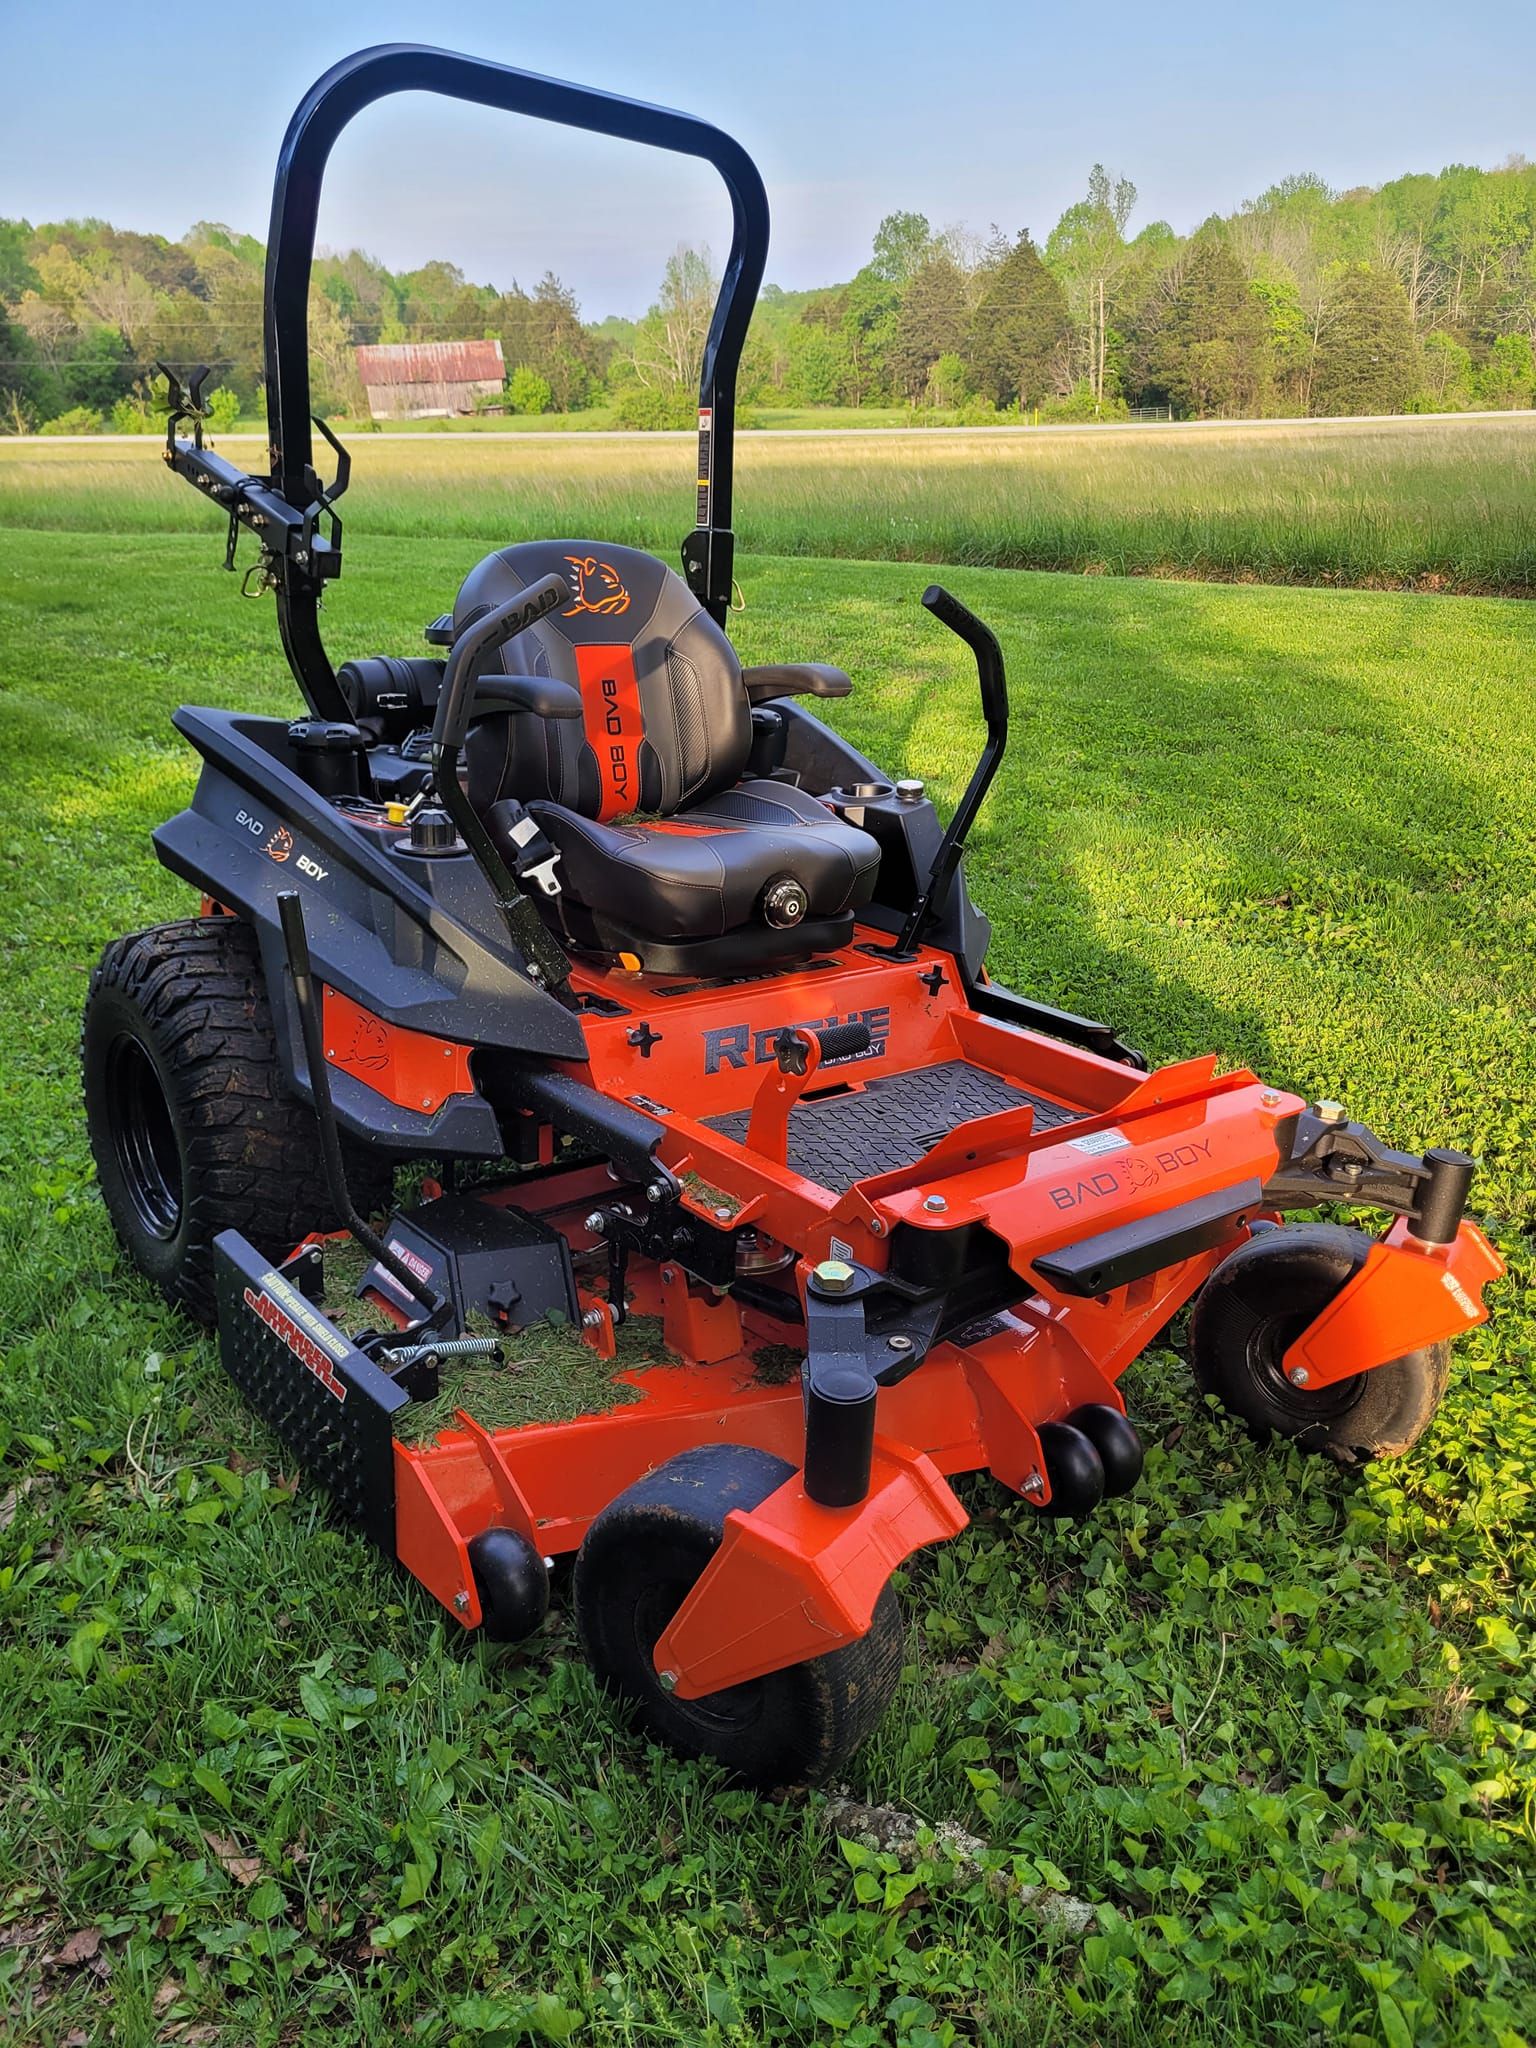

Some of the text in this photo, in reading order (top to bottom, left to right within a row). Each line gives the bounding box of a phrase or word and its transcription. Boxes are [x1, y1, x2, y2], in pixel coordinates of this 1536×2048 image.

[500, 587, 559, 633] BAD
[601, 679, 628, 801] BAD BOY
[235, 809, 329, 881] BAD BOY
[1049, 1138, 1213, 1210] BAD BOY
[408, 1256, 431, 1280] DANGER
